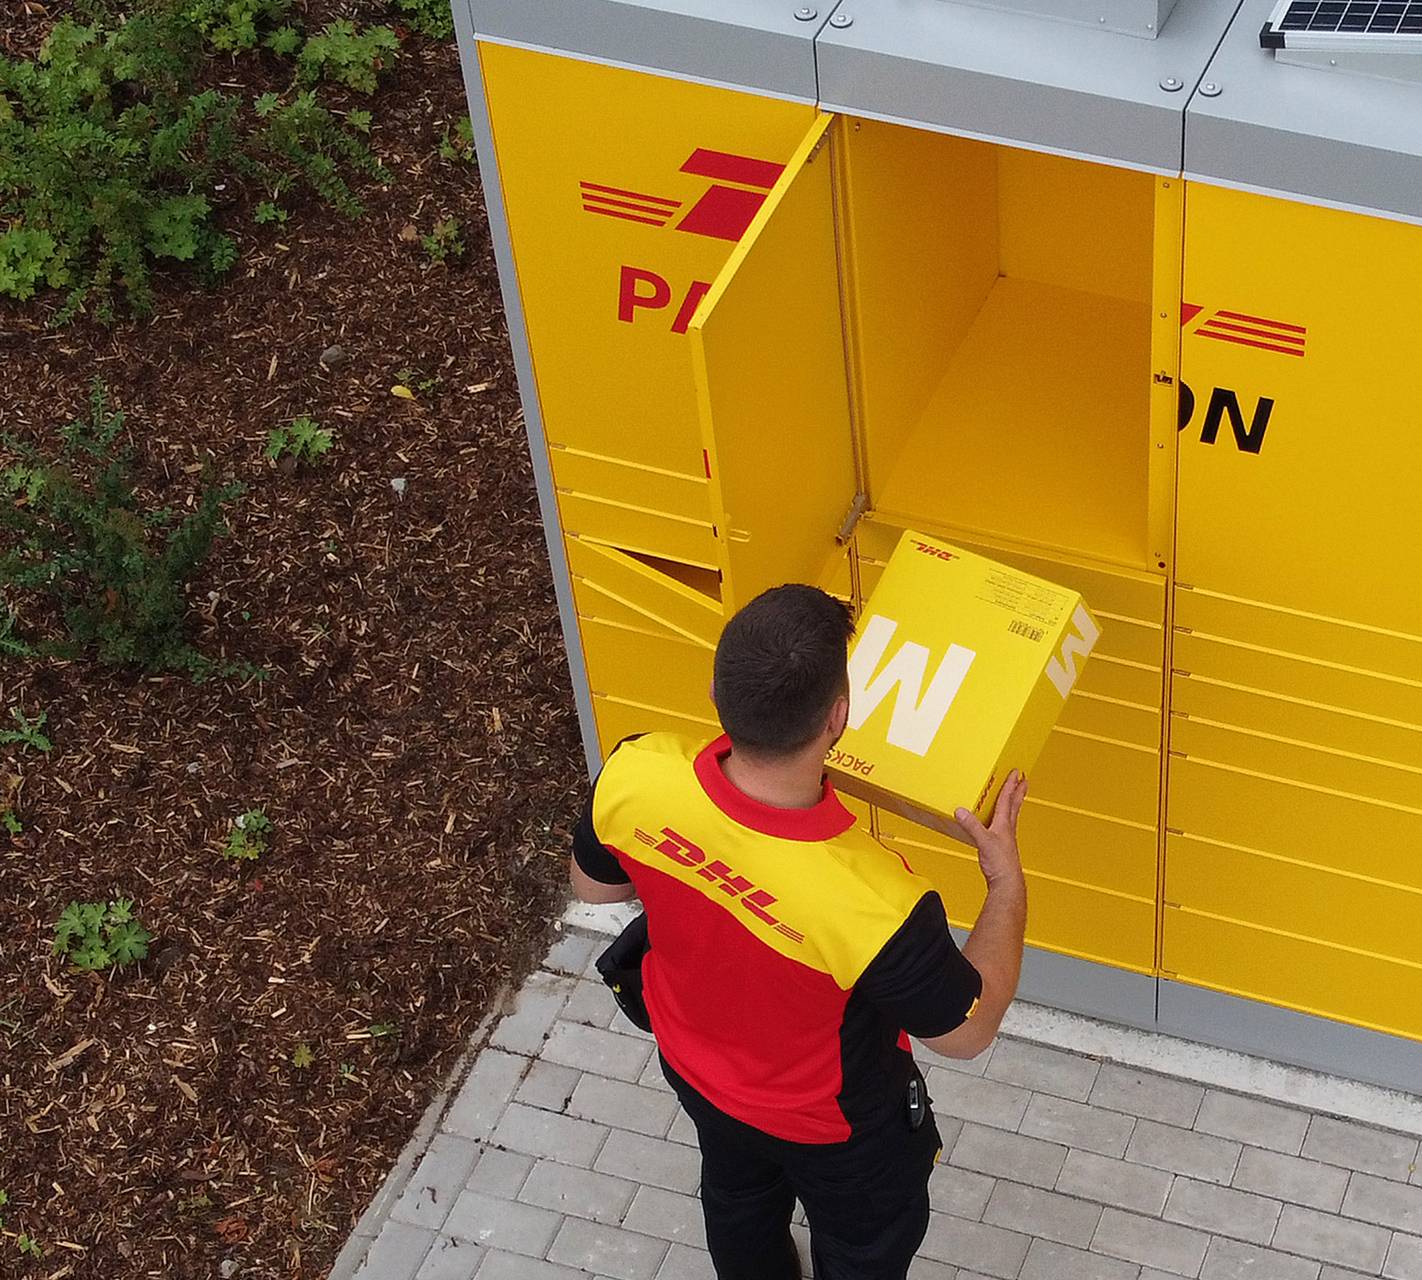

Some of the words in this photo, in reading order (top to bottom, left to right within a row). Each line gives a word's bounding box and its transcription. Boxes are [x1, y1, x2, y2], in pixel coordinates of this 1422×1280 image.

[1178, 379, 1275, 454] N
[846, 614, 976, 757] M
[1045, 602, 1100, 699] M
[654, 826, 779, 926] DHL
